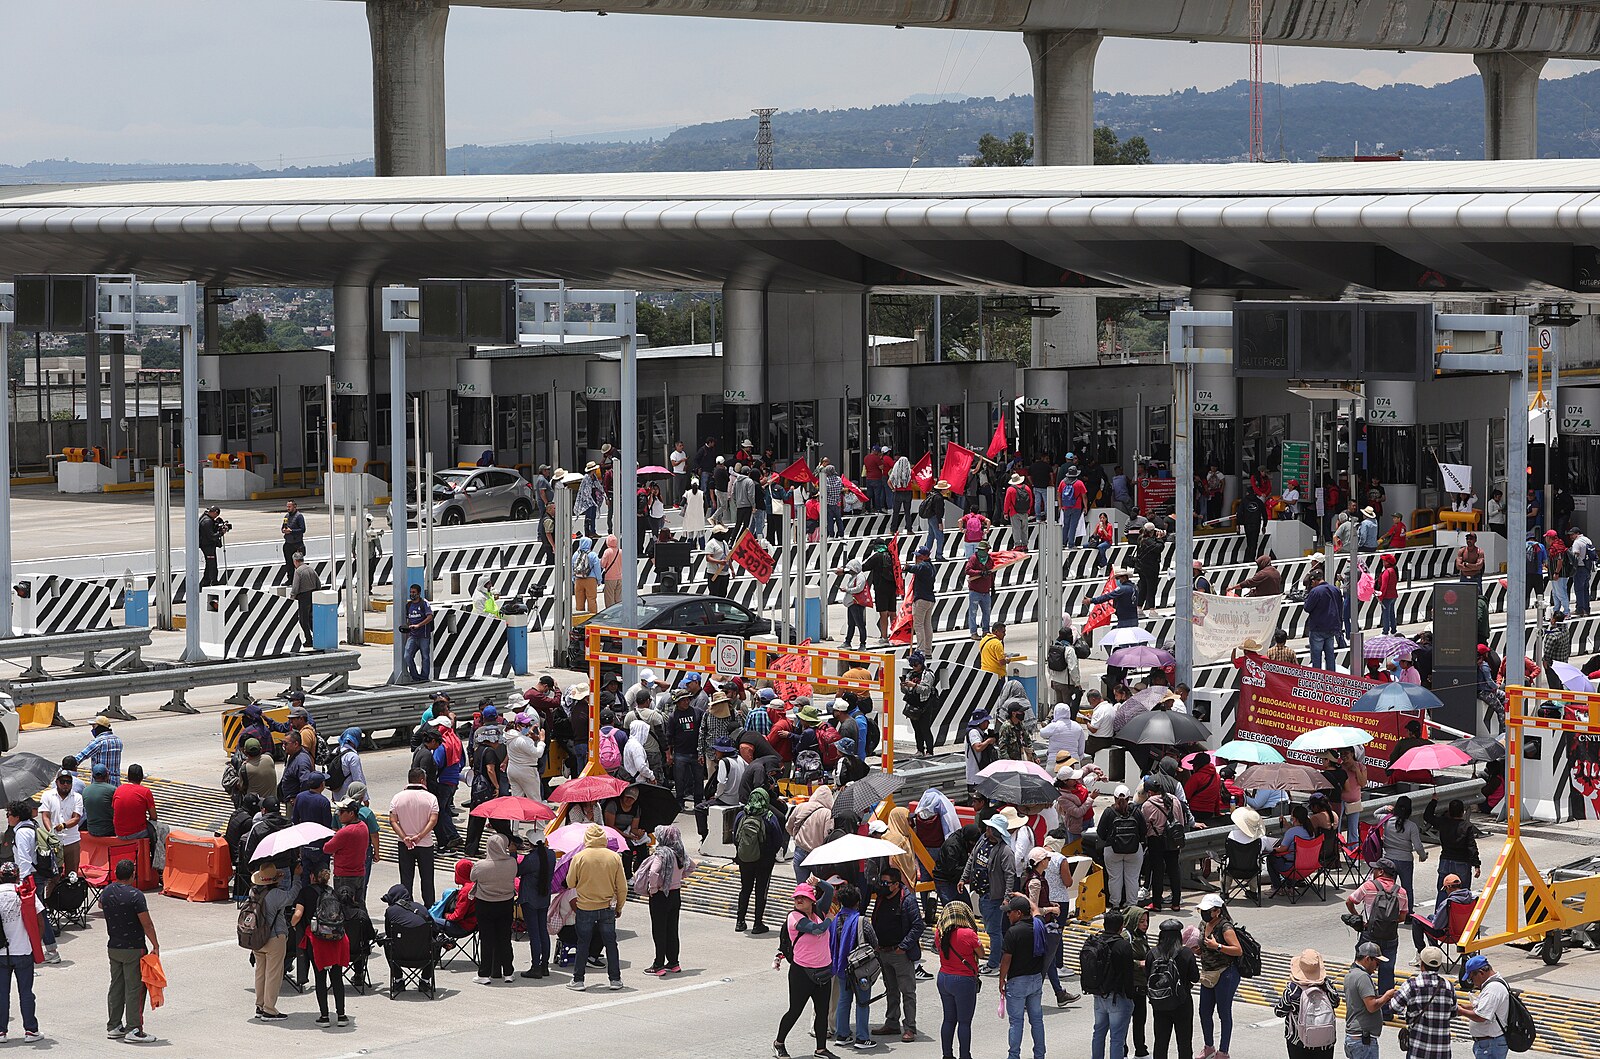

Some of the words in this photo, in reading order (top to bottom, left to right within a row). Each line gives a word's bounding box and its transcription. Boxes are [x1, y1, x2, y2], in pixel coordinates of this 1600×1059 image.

[587, 386, 606, 395] 074
[725, 390, 746, 399] 074
[1198, 391, 1213, 399] 074
[870, 394, 892, 403] 074
[1026, 398, 1049, 407] 074
[1376, 398, 1391, 406] 074
[1194, 403, 1220, 412] 074
[1568, 406, 1583, 414] 074
[1370, 410, 1398, 419] 074
[1563, 418, 1592, 428] 074
[1292, 687, 1323, 701] REGIÓN
[1324, 694, 1351, 708] COSTA
[1257, 707, 1296, 721] ABROGACIÓN
[1305, 716, 1314, 725] LA
[1258, 696, 1297, 710] ABROGACIÓN
[1297, 704, 1306, 712] DE
[1306, 706, 1316, 714] LA
[1316, 707, 1328, 716] LEY
[1329, 710, 1341, 719] DEL
[1341, 713, 1364, 724] ISSSTE
[1364, 718, 1380, 727] 2007
[679, 716, 694, 724] ITALY
[1238, 729, 1283, 746] DELEGACIÓN
[1255, 718, 1285, 729] AUMENTO
[1370, 741, 1387, 751] BASE
